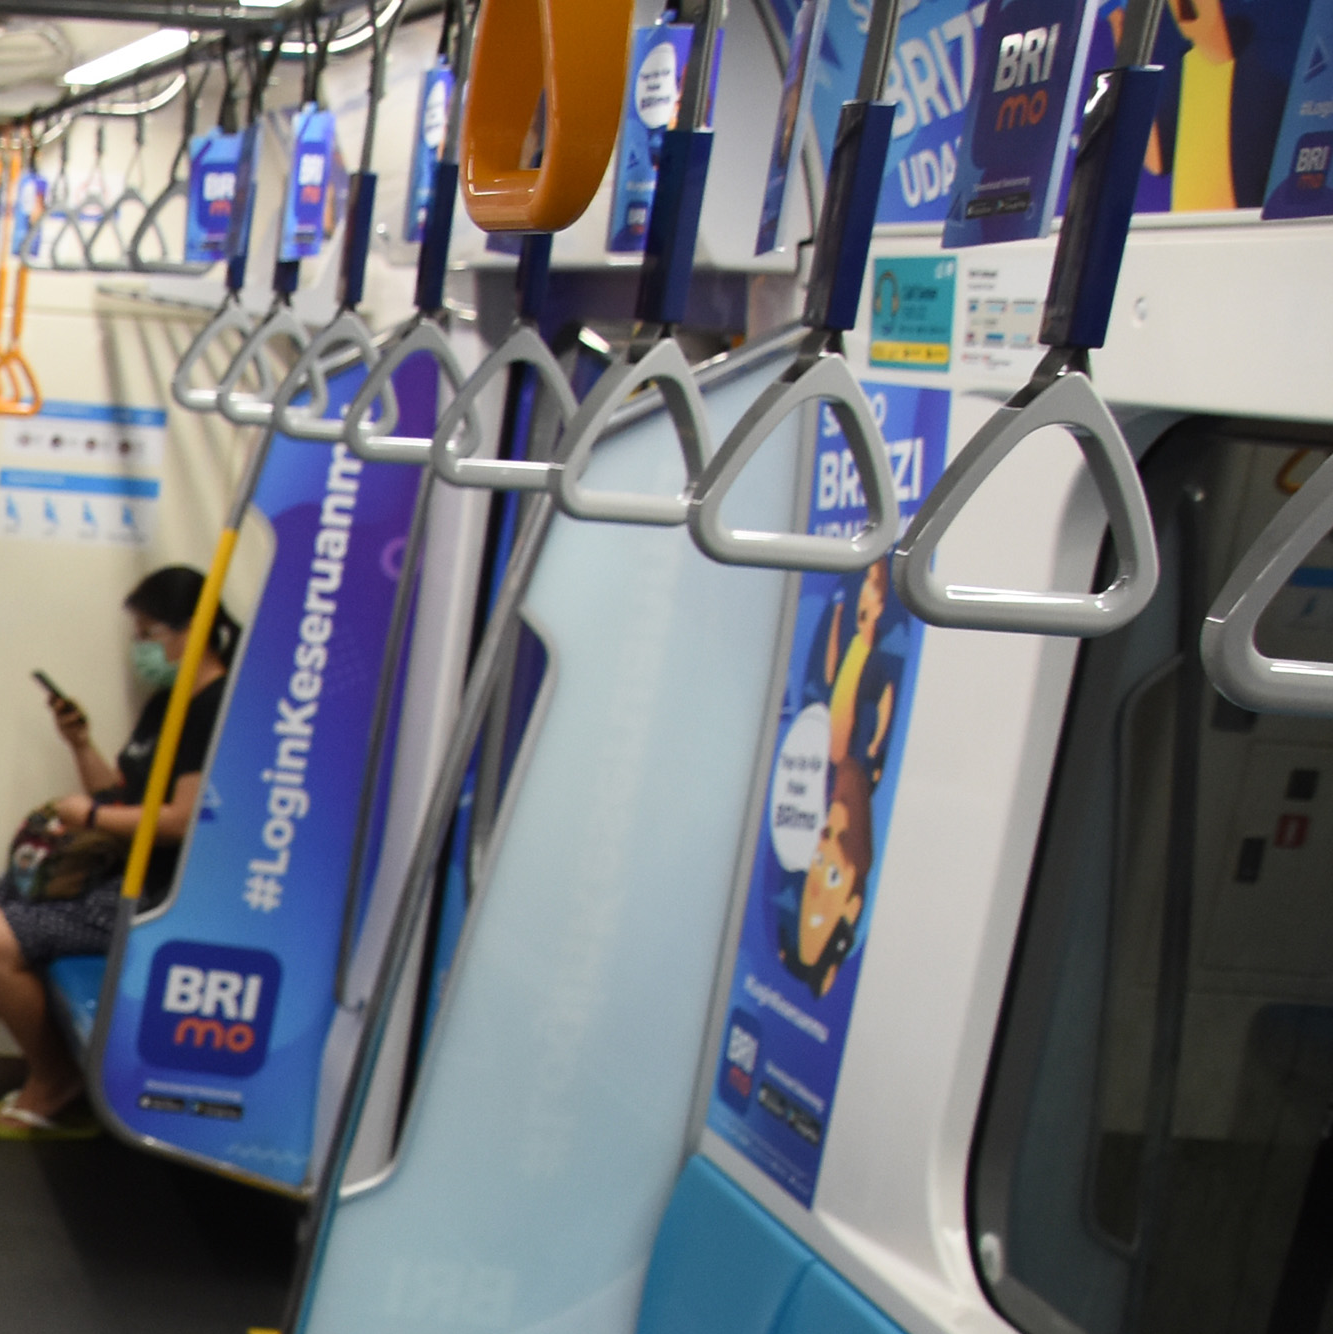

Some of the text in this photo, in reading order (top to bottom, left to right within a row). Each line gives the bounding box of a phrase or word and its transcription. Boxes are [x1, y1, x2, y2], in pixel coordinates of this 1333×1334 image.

[993, 23, 1061, 92] BRI
[996, 89, 1048, 131] mo
[162, 963, 264, 1022] BRI
[173, 1015, 256, 1054] mo
